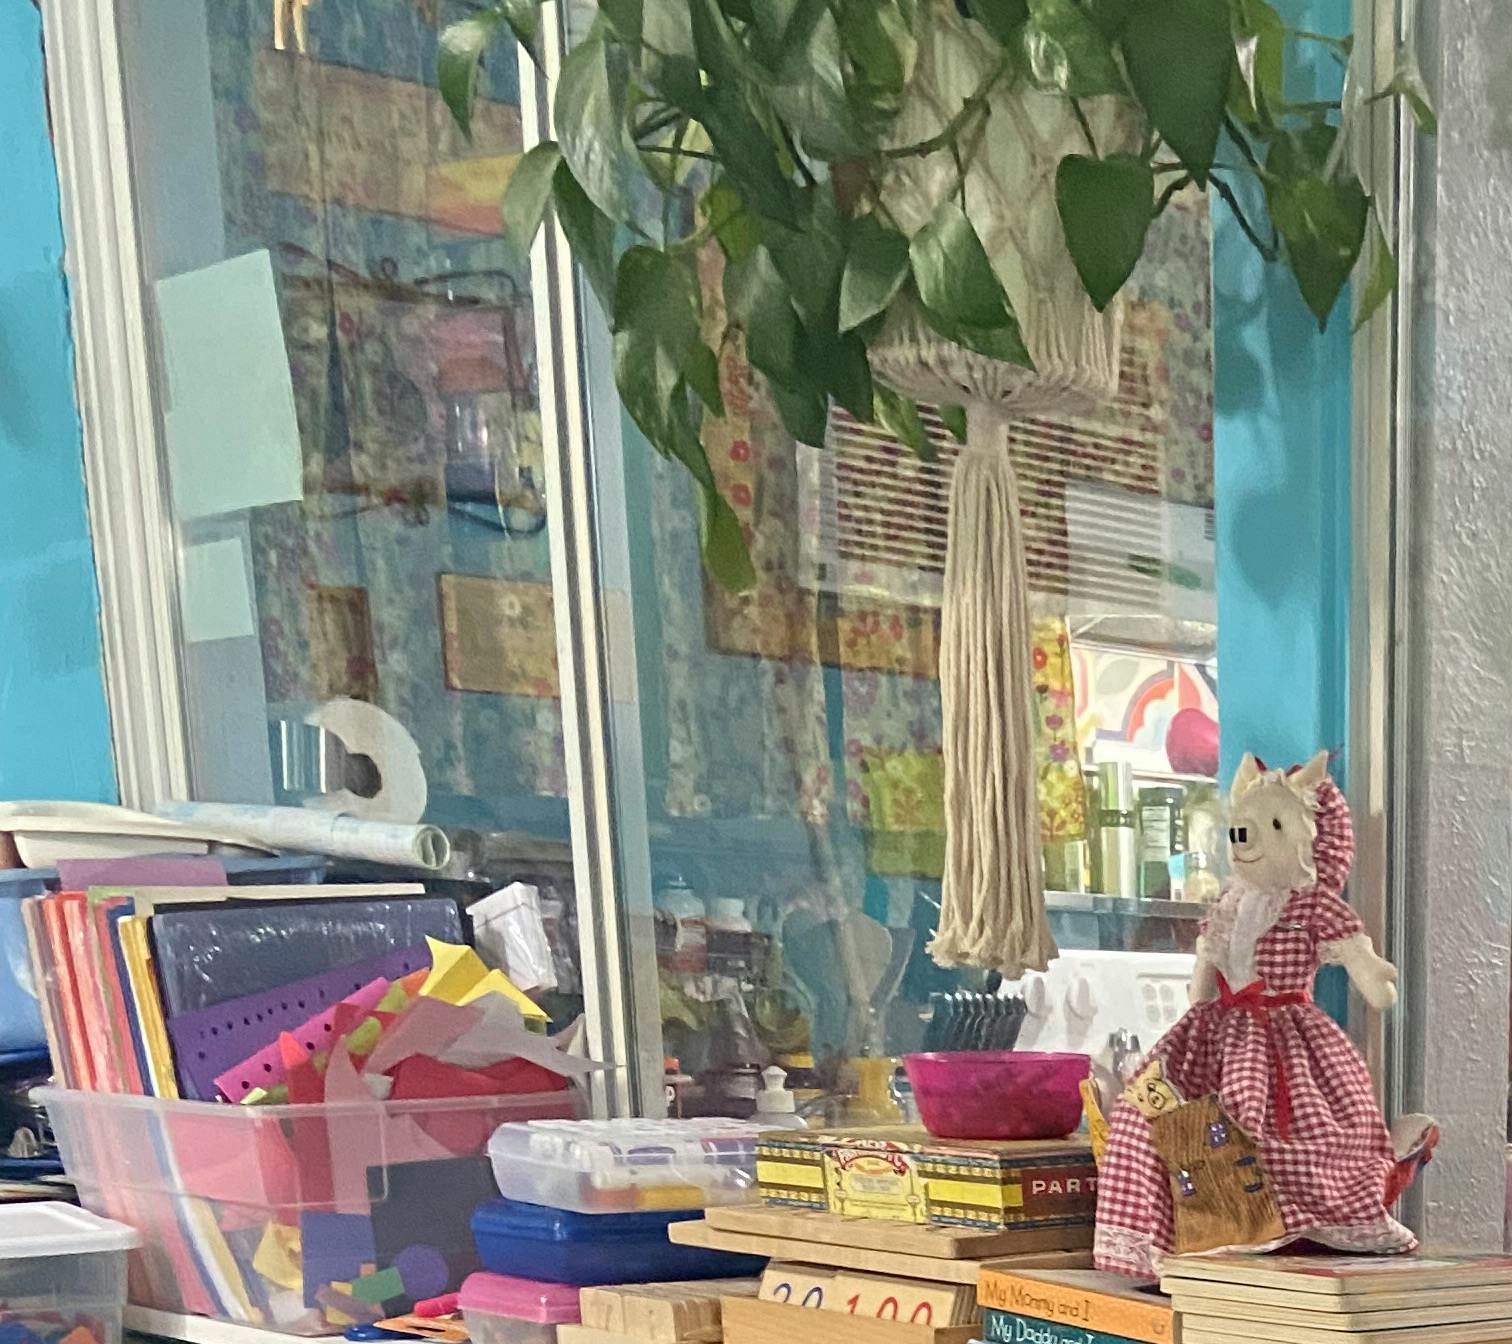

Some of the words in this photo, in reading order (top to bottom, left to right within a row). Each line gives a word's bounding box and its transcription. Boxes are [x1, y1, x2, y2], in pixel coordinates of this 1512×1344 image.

[985, 1280, 1006, 1305] My
[1011, 1287, 1054, 1316] Mommy
[1058, 1301, 1079, 1317] and
[1083, 1300, 1090, 1321] I
[991, 1315, 1013, 1341] My
